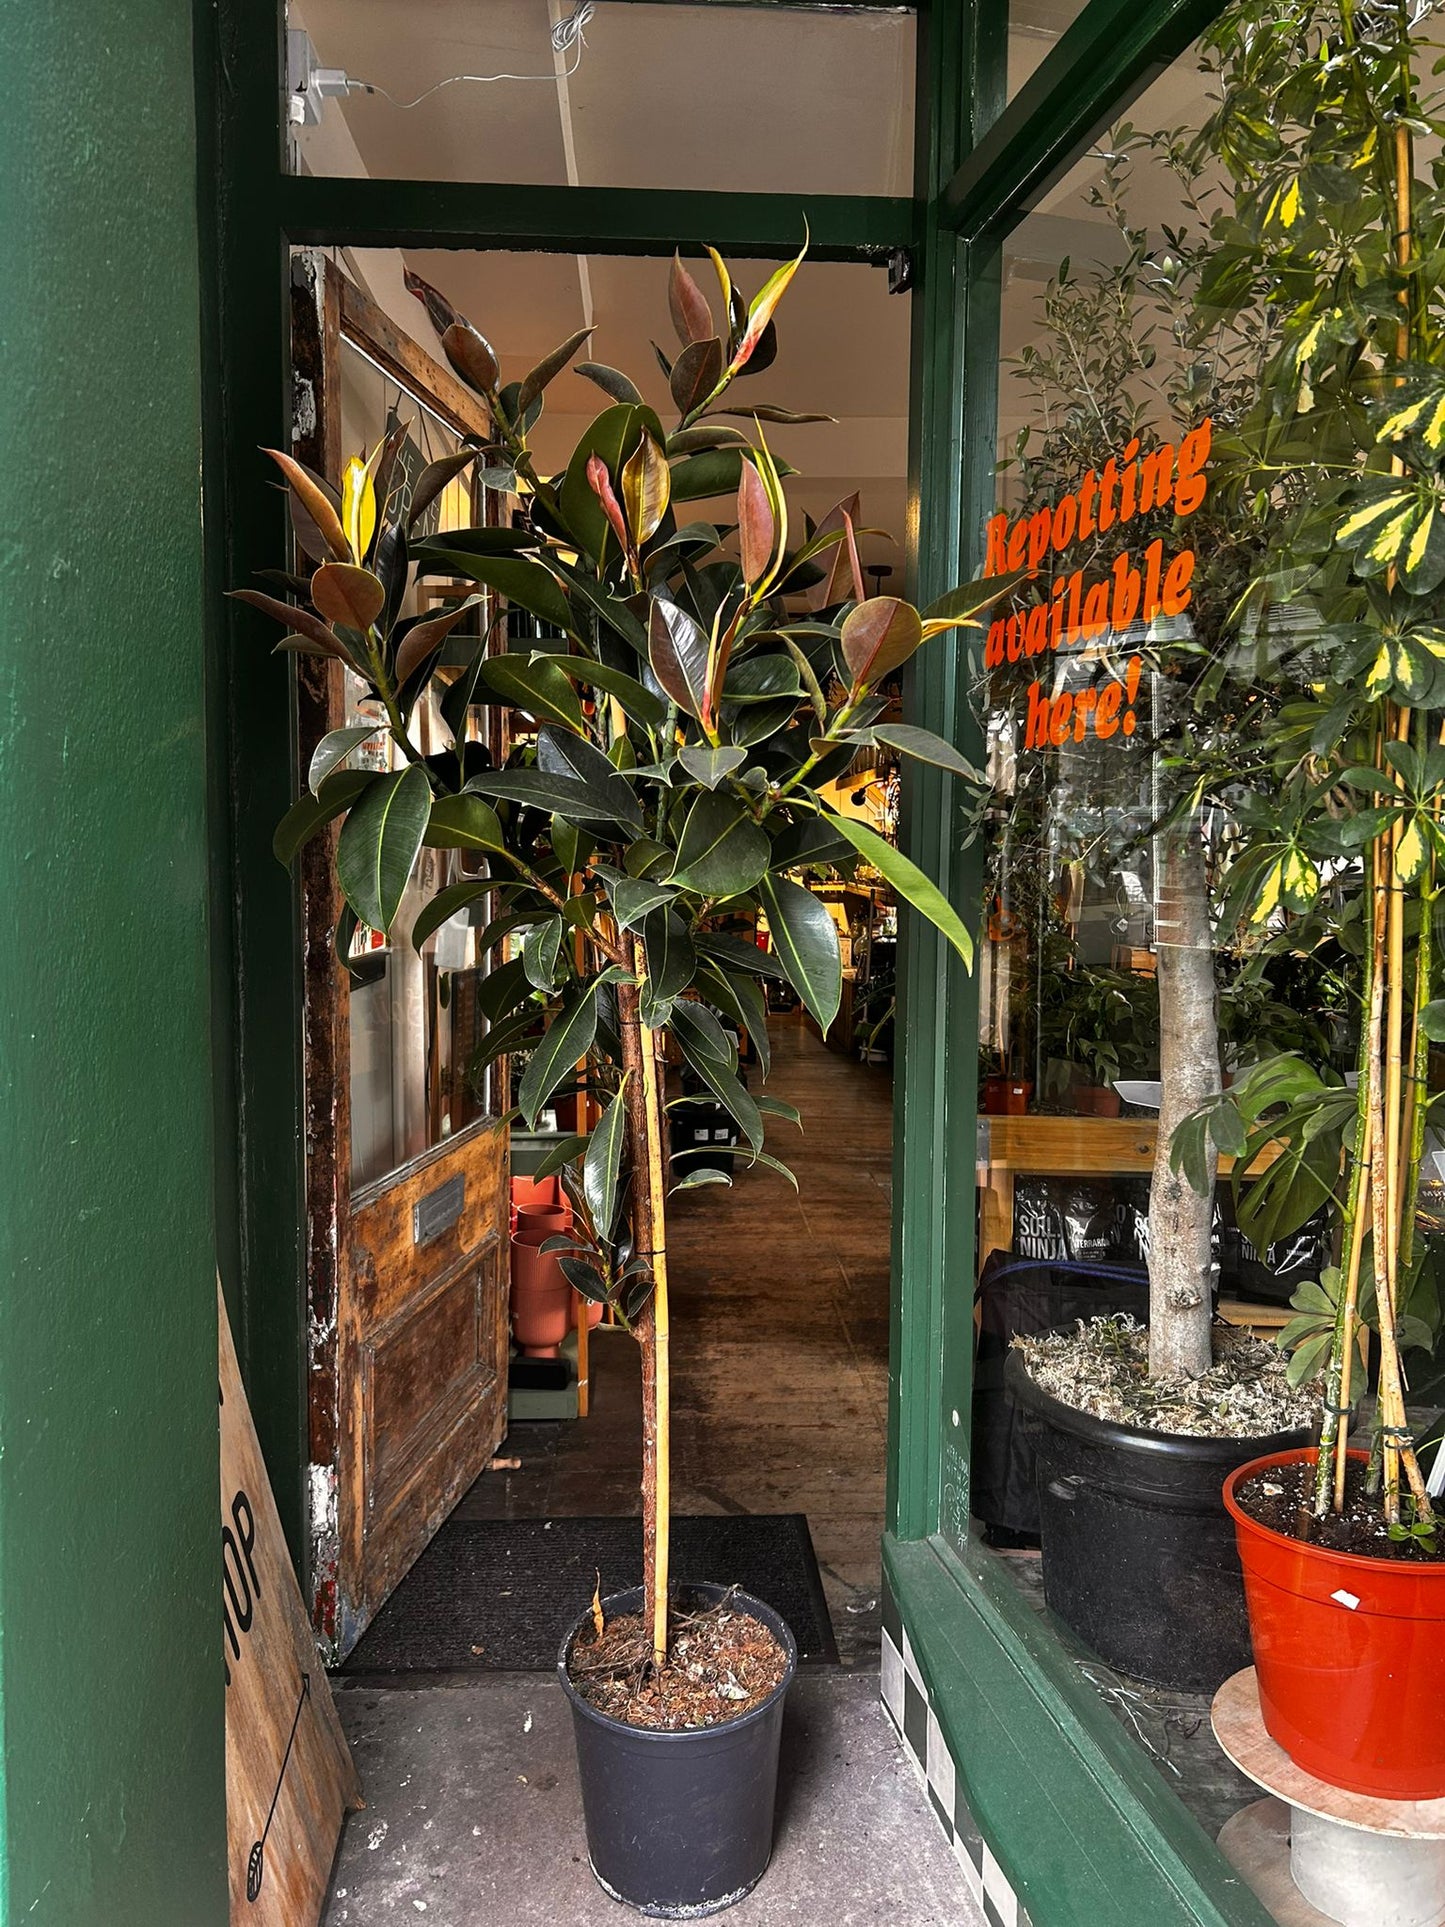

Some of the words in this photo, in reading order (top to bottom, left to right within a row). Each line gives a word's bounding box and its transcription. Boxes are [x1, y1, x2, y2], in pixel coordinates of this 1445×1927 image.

[984, 417, 1212, 579] Repotting
[985, 539, 1195, 669] available
[1025, 656, 1142, 749] here!
[1019, 1236, 1068, 1260] NINJA
